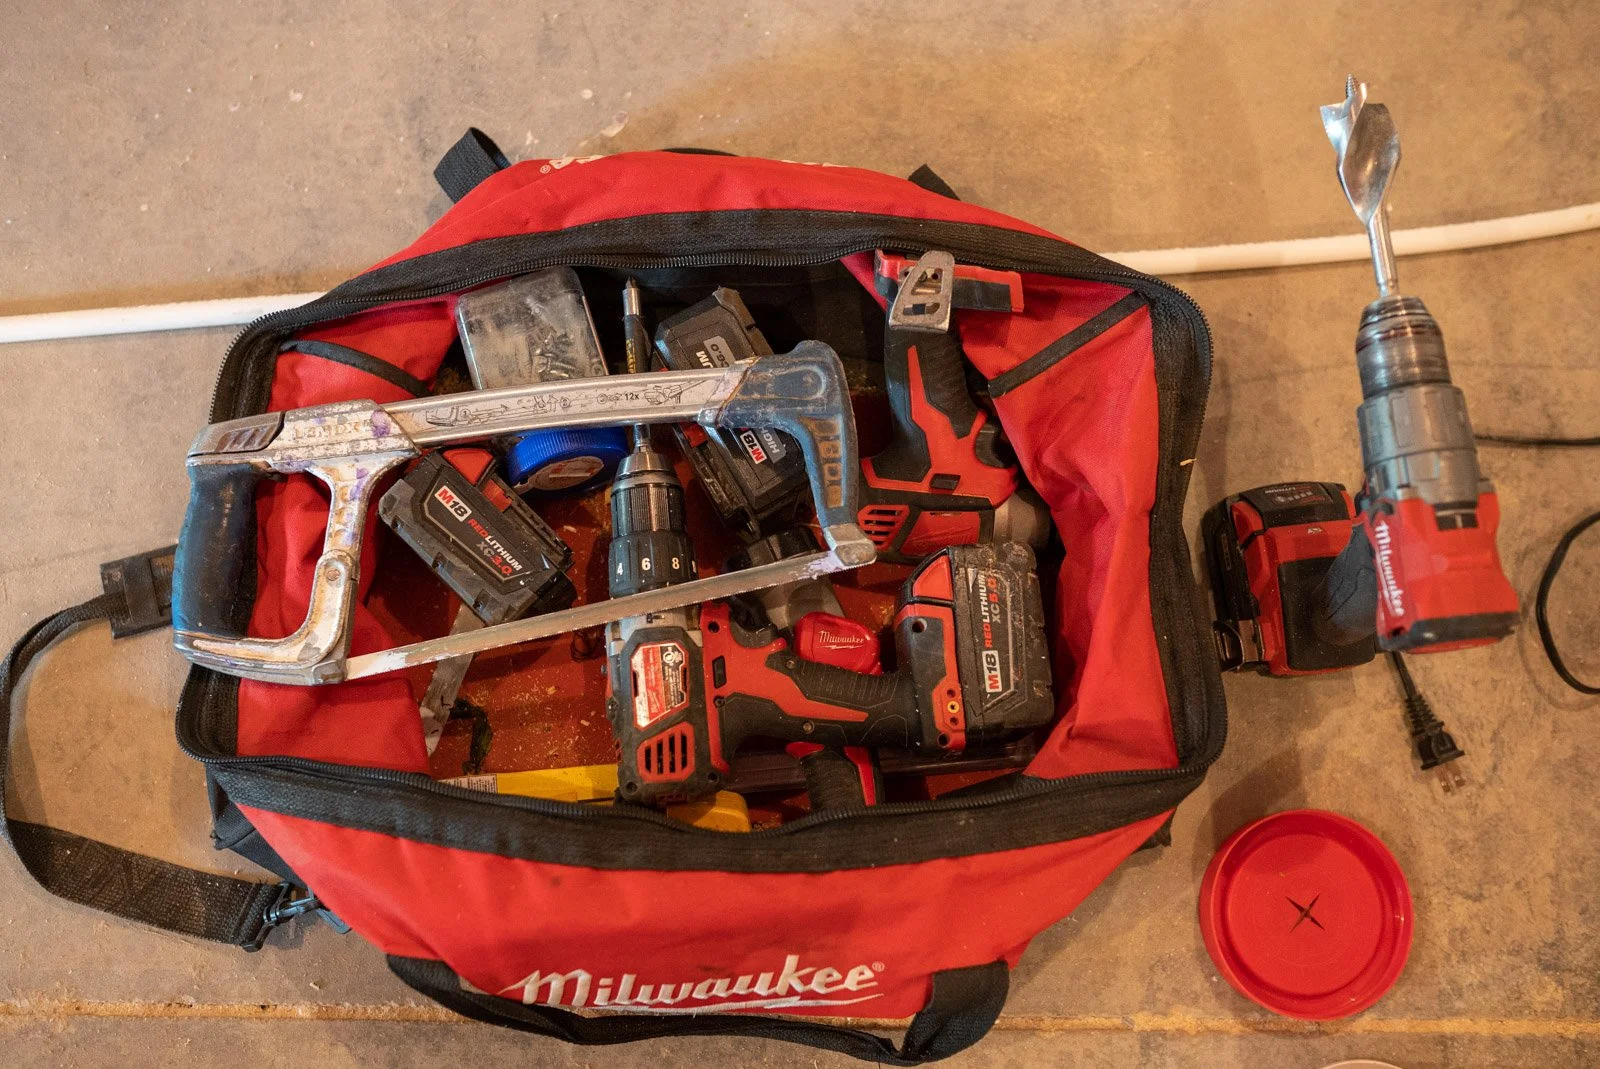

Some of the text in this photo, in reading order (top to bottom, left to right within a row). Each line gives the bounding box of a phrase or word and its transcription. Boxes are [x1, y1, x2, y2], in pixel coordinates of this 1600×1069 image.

[624, 392, 640, 401] 12x
[742, 433, 765, 463] M18
[437, 487, 523, 571] M18 REDLITHIUM
[616, 561, 624, 576] 4
[641, 557, 651, 571] 6
[671, 557, 680, 570] 8
[978, 571, 1000, 691] M18 REDLITHIUM
[498, 954, 880, 1007] Milwaukee
